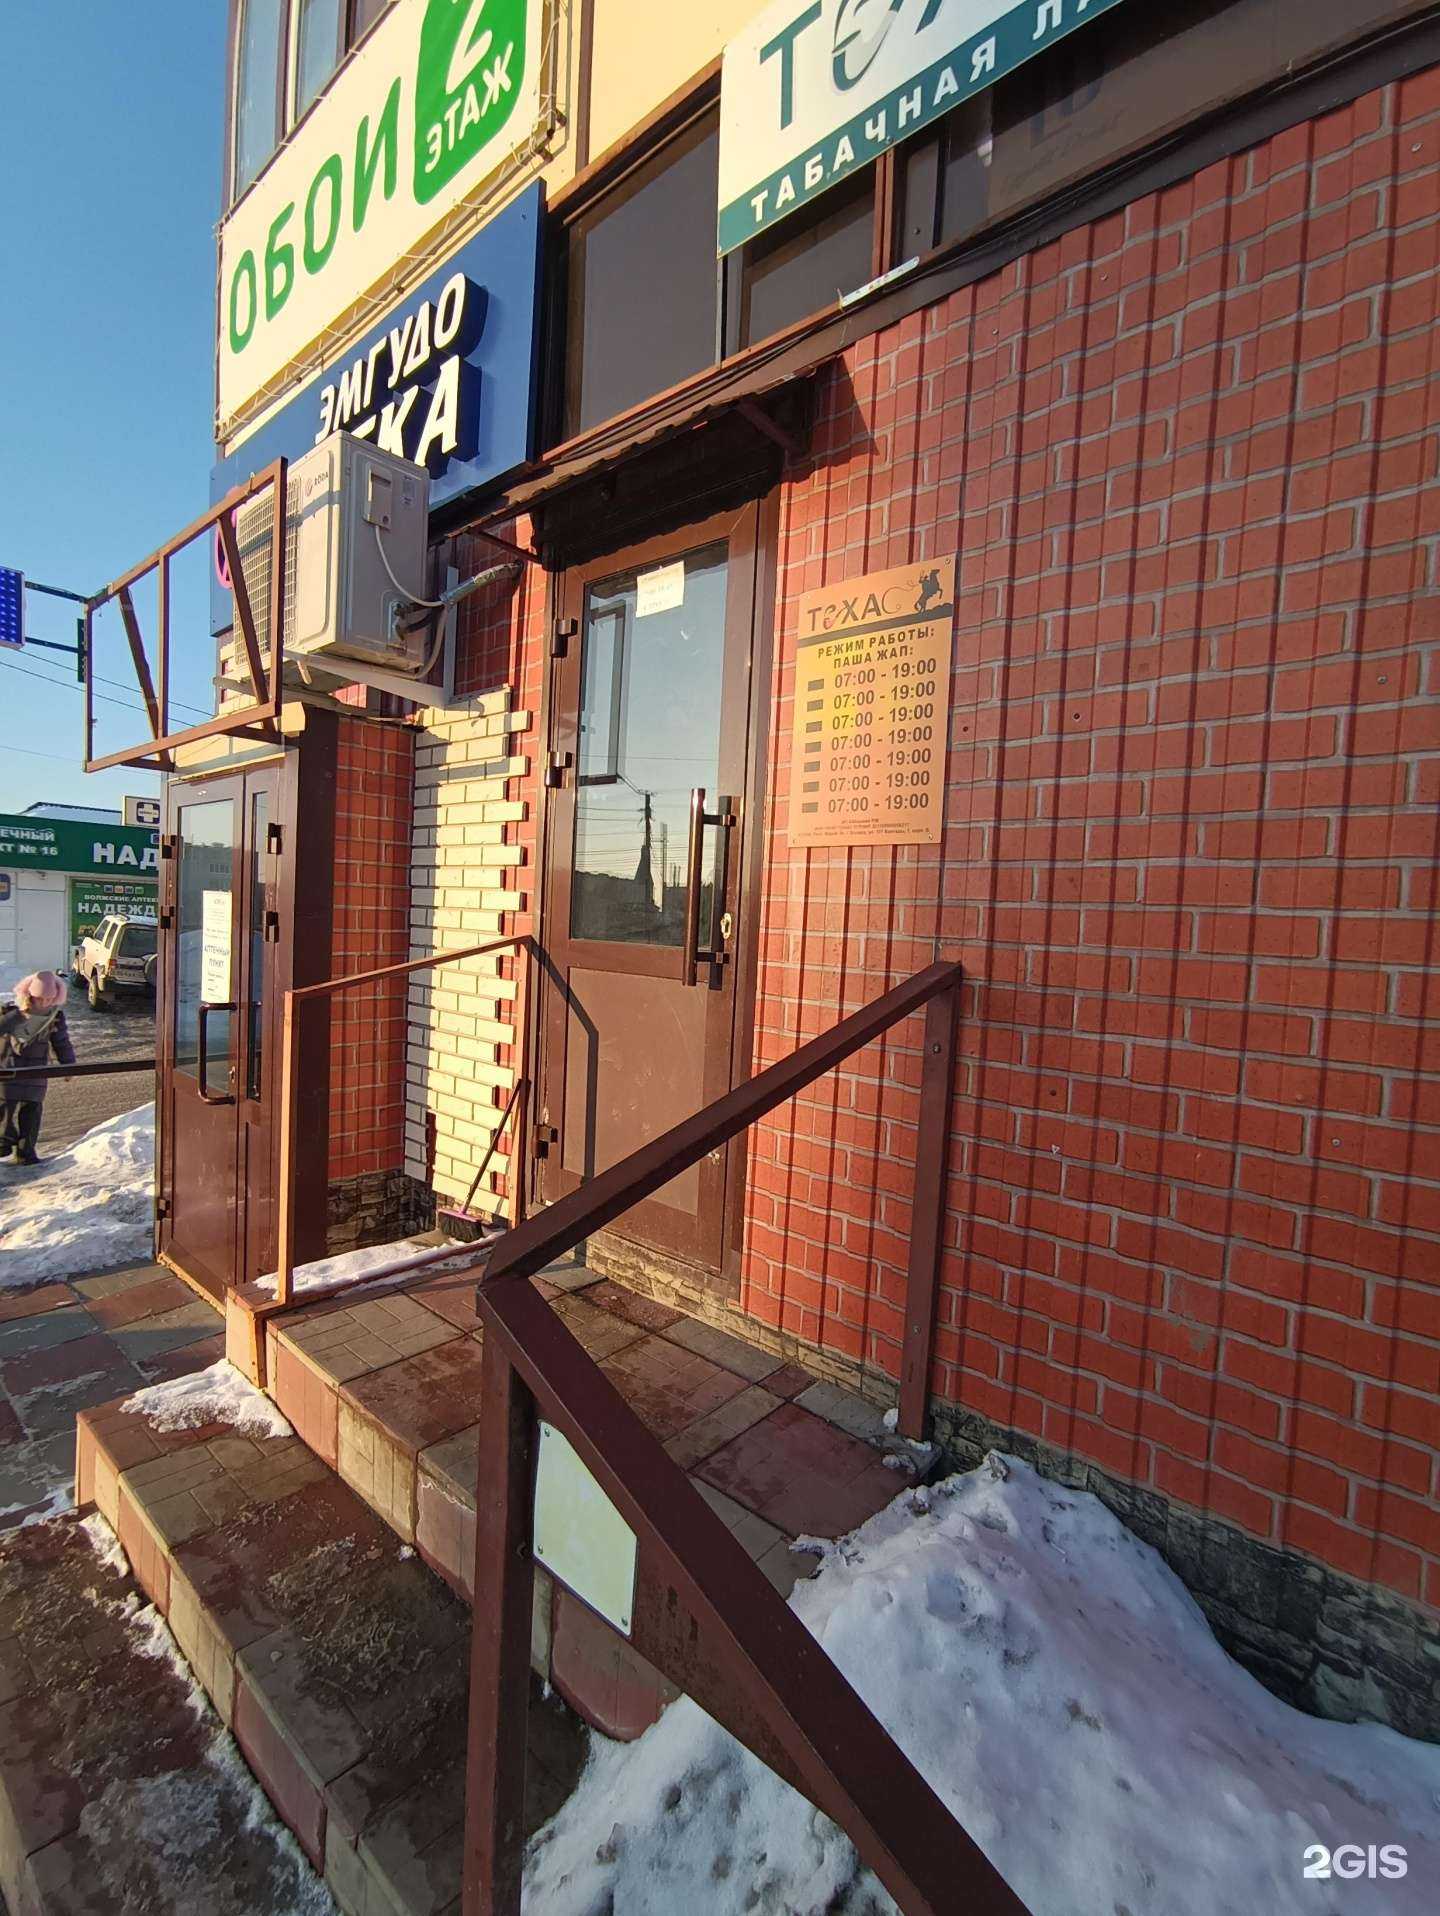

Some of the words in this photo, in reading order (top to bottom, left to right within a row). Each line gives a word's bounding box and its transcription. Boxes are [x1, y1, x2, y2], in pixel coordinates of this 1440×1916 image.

[445, 0, 494, 95] 2
[424, 41, 515, 174] ЭТАЖ
[750, 36, 997, 224] ТАБАЧНАЯ
[1032, 0, 1091, 41] Л
[229, 75, 402, 355] ОБОИ
[314, 273, 467, 445] ЭМГУДО
[350, 354, 460, 467] КА
[817, 640, 865, 658] РЕЖИМ
[869, 627, 935, 648] РАБОТЫ:
[833, 652, 872, 669] ПАША
[877, 645, 914, 661] ЖАП:
[834, 668, 875, 688] 07:00
[892, 658, 936, 679] 19:00
[834, 690, 874, 710] 07:00
[891, 680, 936, 701] 19:00
[832, 712, 873, 730] 07:00
[889, 703, 934, 722] 19:00
[832, 733, 872, 750] 07:00
[888, 726, 932, 744] 19:00
[830, 754, 870, 772] 07:00
[887, 748, 931, 766] 19:00
[829, 776, 870, 792] 07:00
[886, 771, 930, 788] 19:00
[828, 797, 868, 813] 07:00
[885, 793, 929, 810] 19:00
[42, 846, 58, 856] 16
